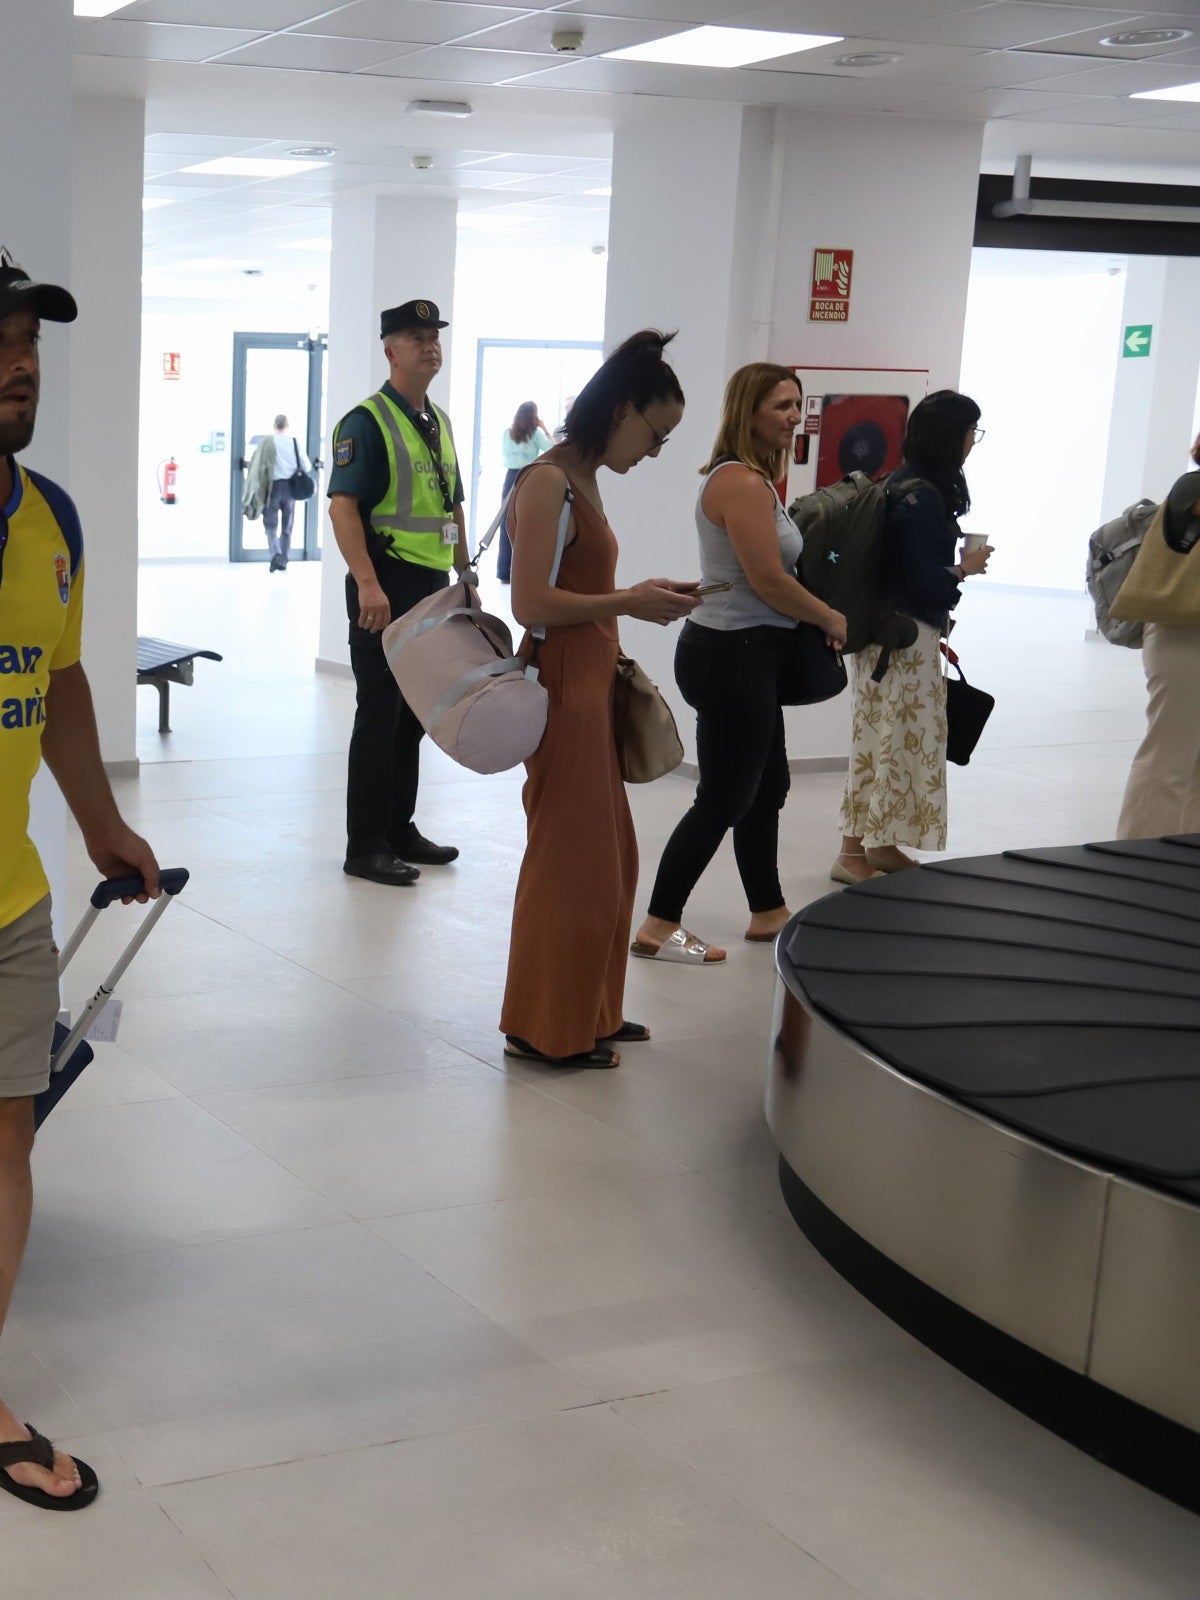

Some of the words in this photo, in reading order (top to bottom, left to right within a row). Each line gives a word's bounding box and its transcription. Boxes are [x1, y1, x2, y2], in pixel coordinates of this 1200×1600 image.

[815, 302, 834, 310] BOCA
[835, 302, 845, 311] DE
[812, 311, 846, 320] INCENDIO
